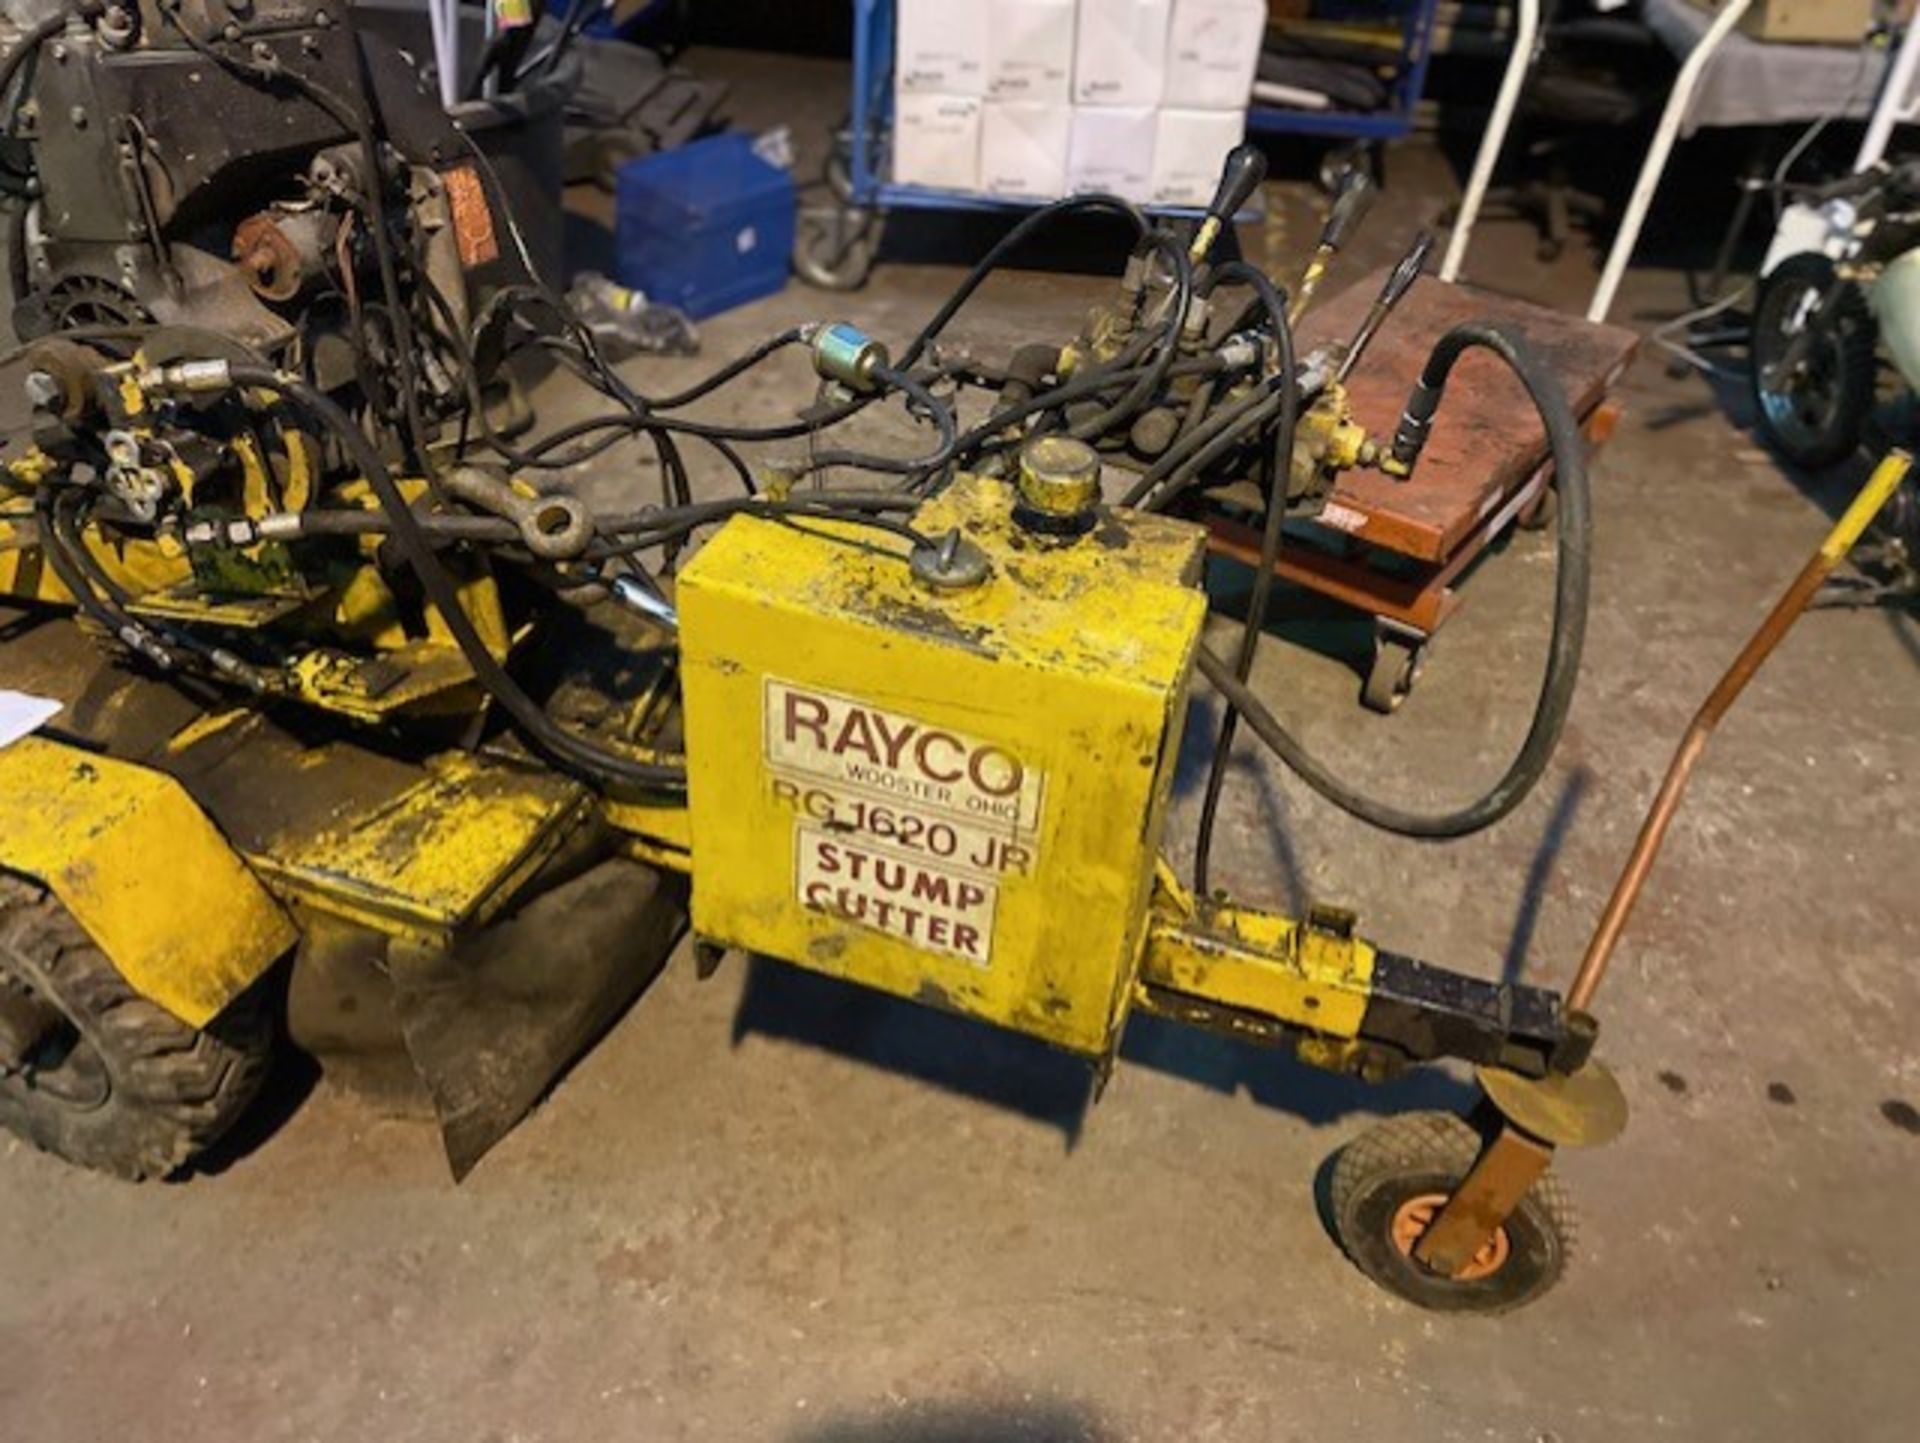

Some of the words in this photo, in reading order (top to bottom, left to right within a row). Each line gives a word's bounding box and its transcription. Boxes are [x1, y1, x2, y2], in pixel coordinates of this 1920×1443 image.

[785, 692, 1024, 797] RAYCO
[772, 779, 836, 820] RG
[849, 802, 957, 857] 1620
[970, 836, 1031, 878] JR
[846, 763, 952, 803] WOOSTER
[966, 796, 1020, 820] OHIO
[817, 842, 985, 911] STUMP
[805, 881, 980, 955] CUTTER
